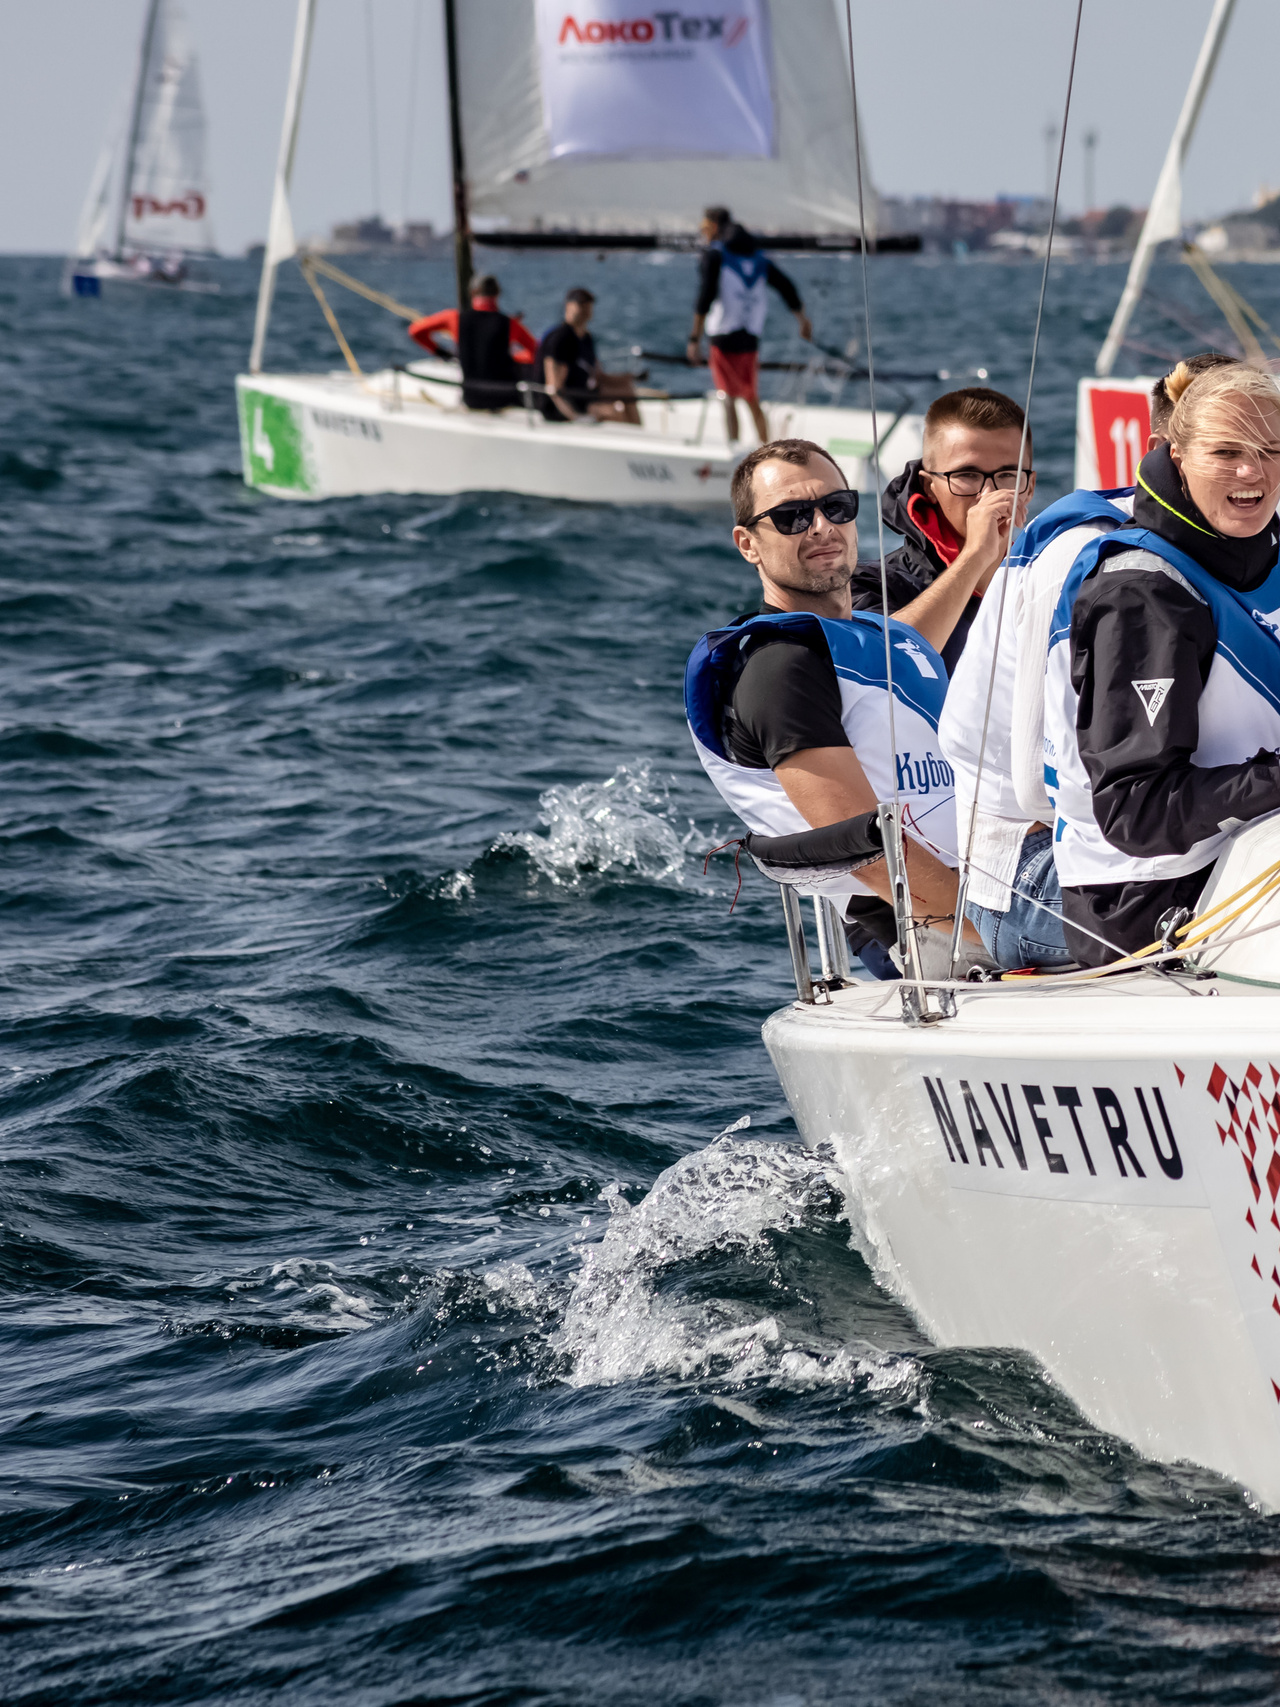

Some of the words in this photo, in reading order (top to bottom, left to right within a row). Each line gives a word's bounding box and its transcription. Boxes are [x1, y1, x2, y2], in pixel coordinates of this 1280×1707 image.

[253, 407, 274, 472] 4
[1110, 416, 1141, 489] 11
[923, 1076, 1184, 1180] NAVETRU
